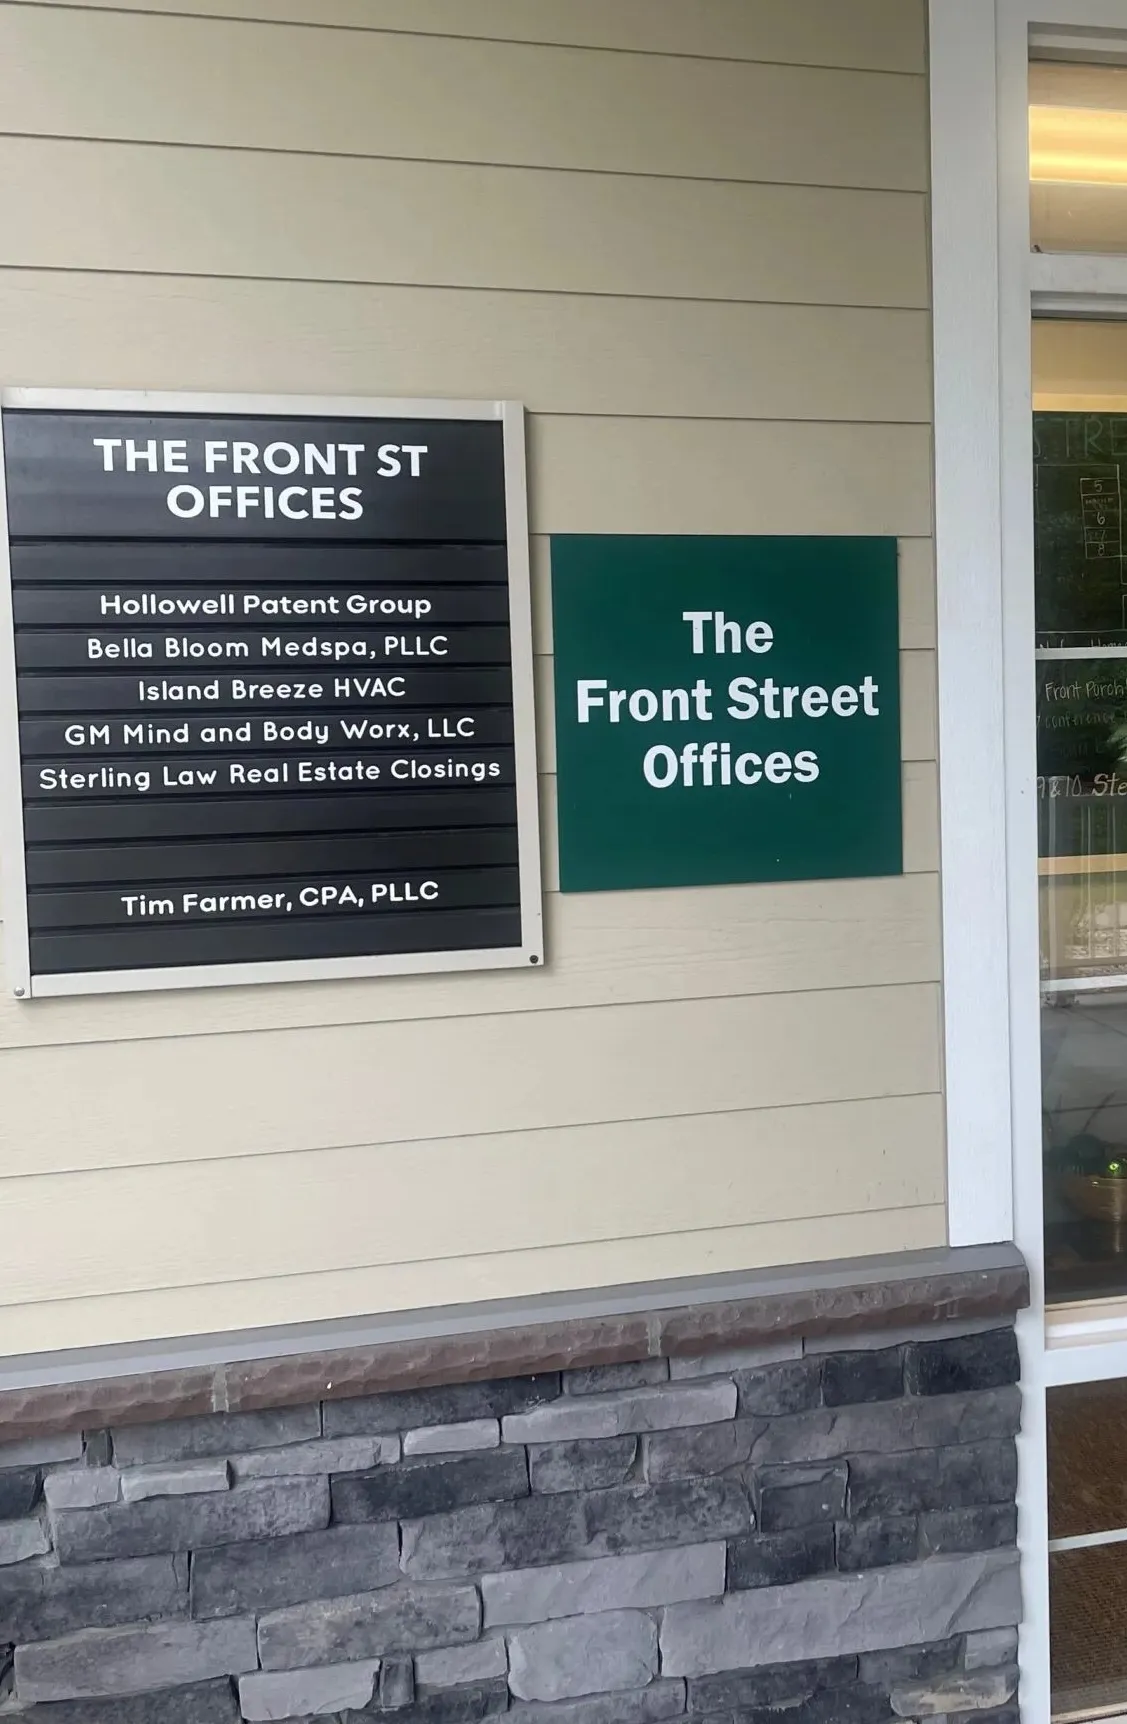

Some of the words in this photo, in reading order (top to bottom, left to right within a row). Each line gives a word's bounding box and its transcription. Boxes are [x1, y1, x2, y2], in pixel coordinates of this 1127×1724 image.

[93, 438, 189, 474] THE
[204, 440, 365, 476] FRONT
[376, 444, 428, 477] ST
[1093, 479, 1105, 493] 5
[166, 484, 364, 521] OFFICES
[1096, 511, 1106, 525] 6
[100, 593, 235, 615] Hollowell
[243, 594, 340, 615] Patent
[346, 594, 432, 619] Group
[87, 637, 153, 659] Bella
[165, 637, 249, 658] Bloom
[261, 636, 376, 661] Medspa,
[384, 635, 448, 656] PLLC
[682, 611, 774, 654] The
[138, 679, 220, 701] Island
[231, 679, 324, 700] Breeze
[334, 676, 406, 698] HVAC
[577, 679, 713, 723] Front
[727, 675, 880, 720] Street
[1045, 682, 1082, 701] Front
[1085, 680, 1124, 698] Porch
[64, 724, 110, 746] GM
[123, 722, 189, 745] Mind
[200, 721, 251, 743] and
[263, 720, 329, 745] Body
[339, 719, 419, 742] Worx,
[427, 717, 475, 738] LLC
[39, 767, 151, 792] Sterling
[163, 765, 217, 786] Law
[229, 762, 289, 785] Real
[298, 760, 381, 782] Estate
[390, 758, 501, 782] Closings
[643, 741, 820, 789] Offices
[121, 894, 175, 917] Tim
[182, 892, 293, 914] Farmer,
[299, 885, 365, 908] CPA,
[371, 880, 439, 903] PLLC
